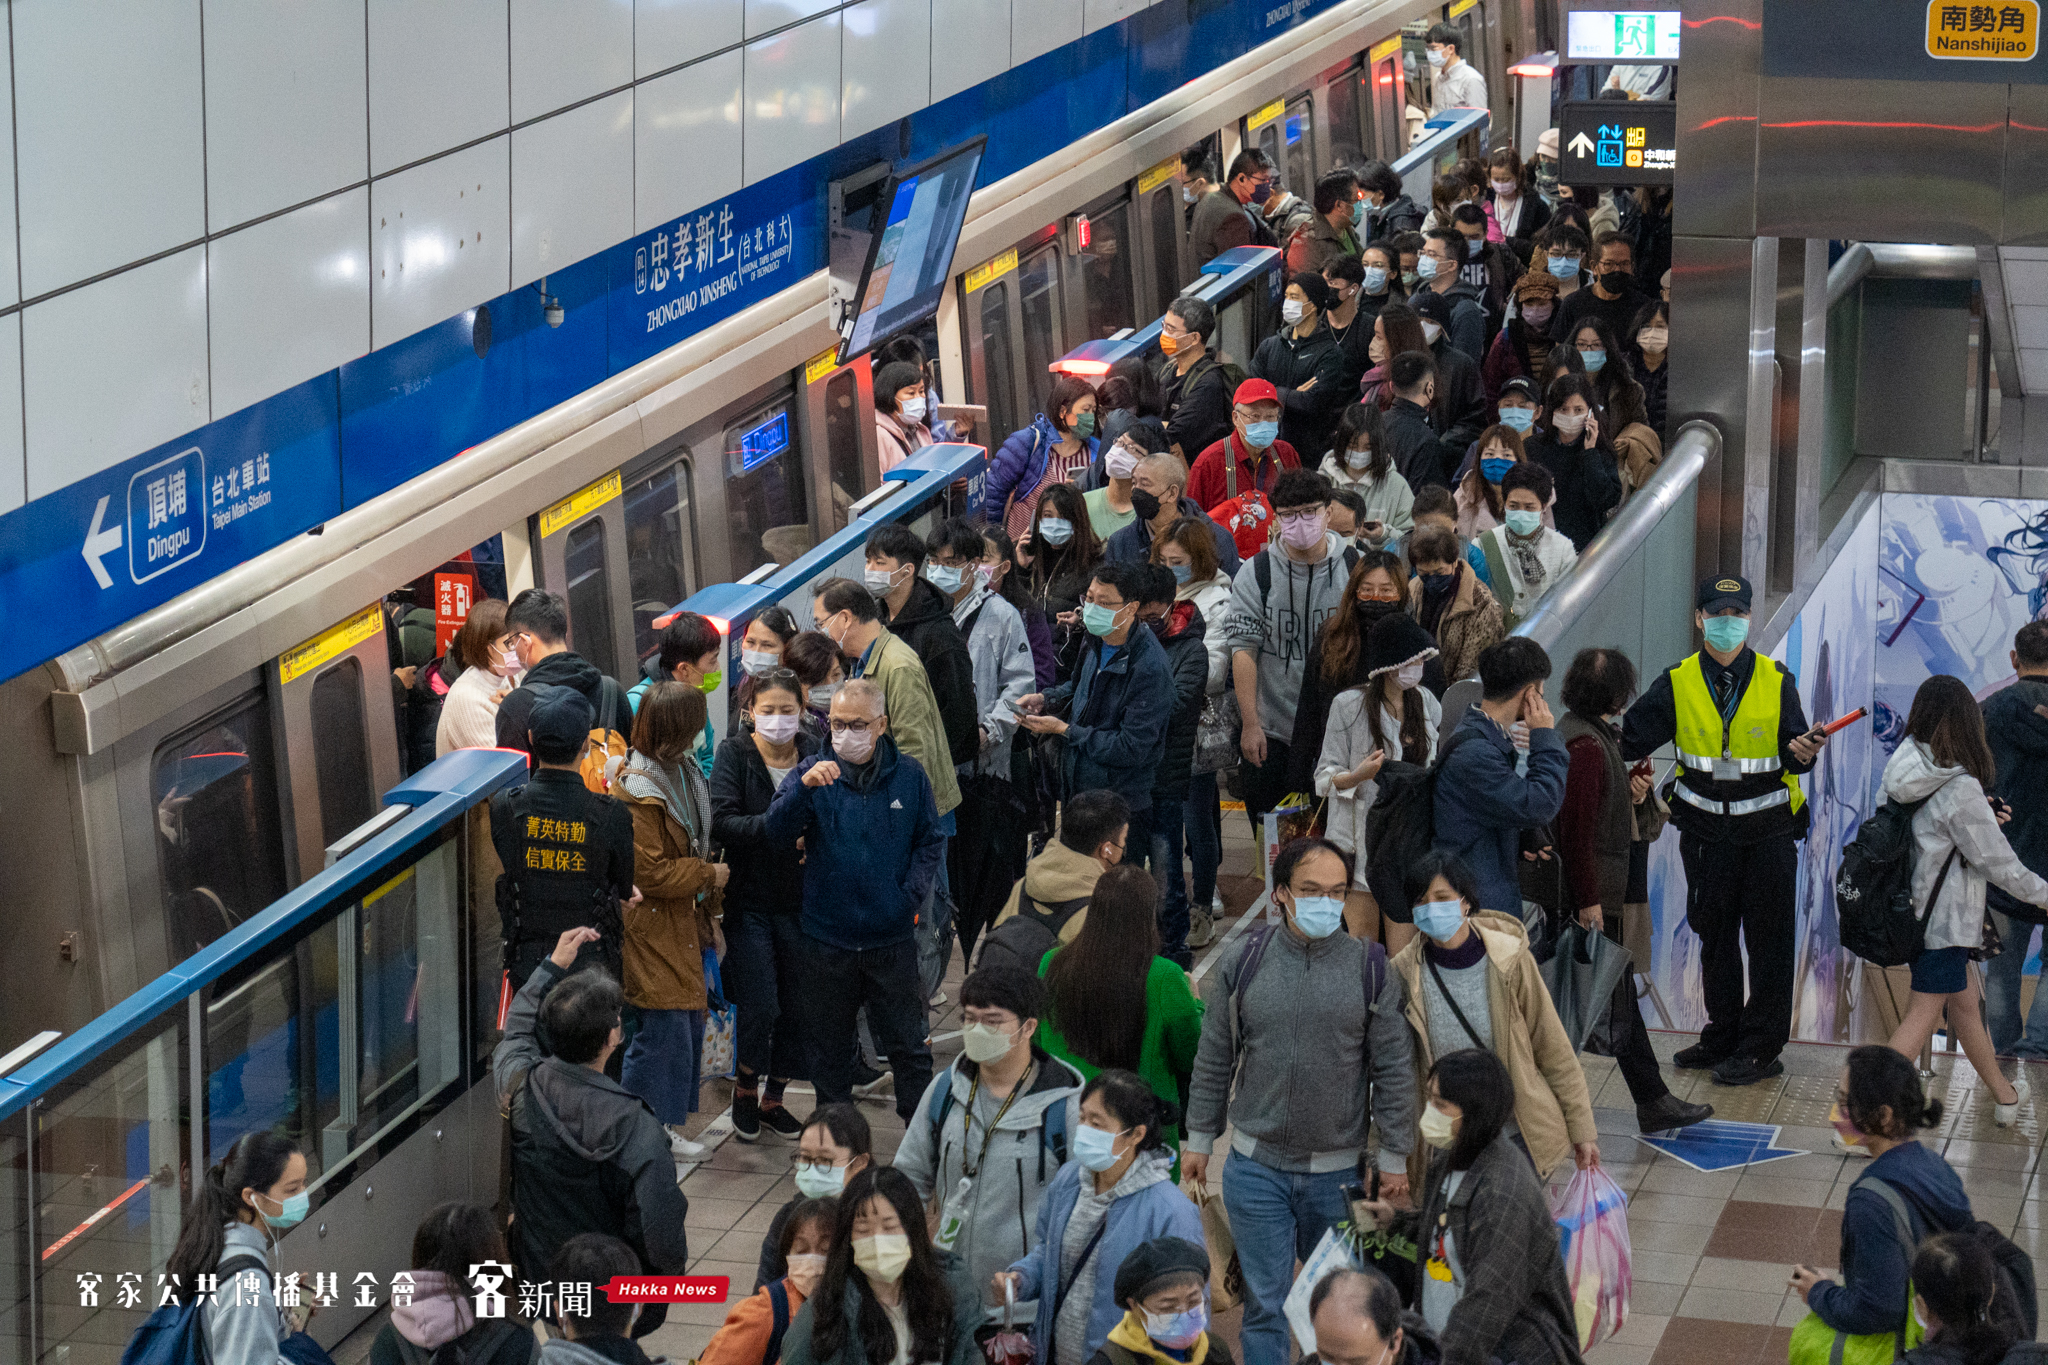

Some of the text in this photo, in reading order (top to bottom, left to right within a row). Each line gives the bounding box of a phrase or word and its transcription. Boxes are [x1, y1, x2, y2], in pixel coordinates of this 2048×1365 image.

[1941, 5, 2025, 33] 南勢角
[1937, 36, 2027, 54] Nanshijiao
[650, 204, 734, 292] 忠孝新生
[741, 259, 758, 275] NATIONAL
[770, 244, 789, 261] UNIVERSITY
[638, 271, 645, 288] 14
[751, 259, 780, 281] OF TECHNOLOGY
[647, 271, 738, 333] ZHONGXIAO XINSHENG
[212, 452, 271, 508] 台北車站
[979, 471, 986, 503] 3
[147, 468, 187, 530] 頂埔
[212, 490, 272, 530] Taipei Main Station
[148, 527, 190, 562] Dingpu
[440, 580, 452, 615] 滅火器
[526, 815, 586, 844] 菁英特勤
[525, 846, 586, 872] 信實保全
